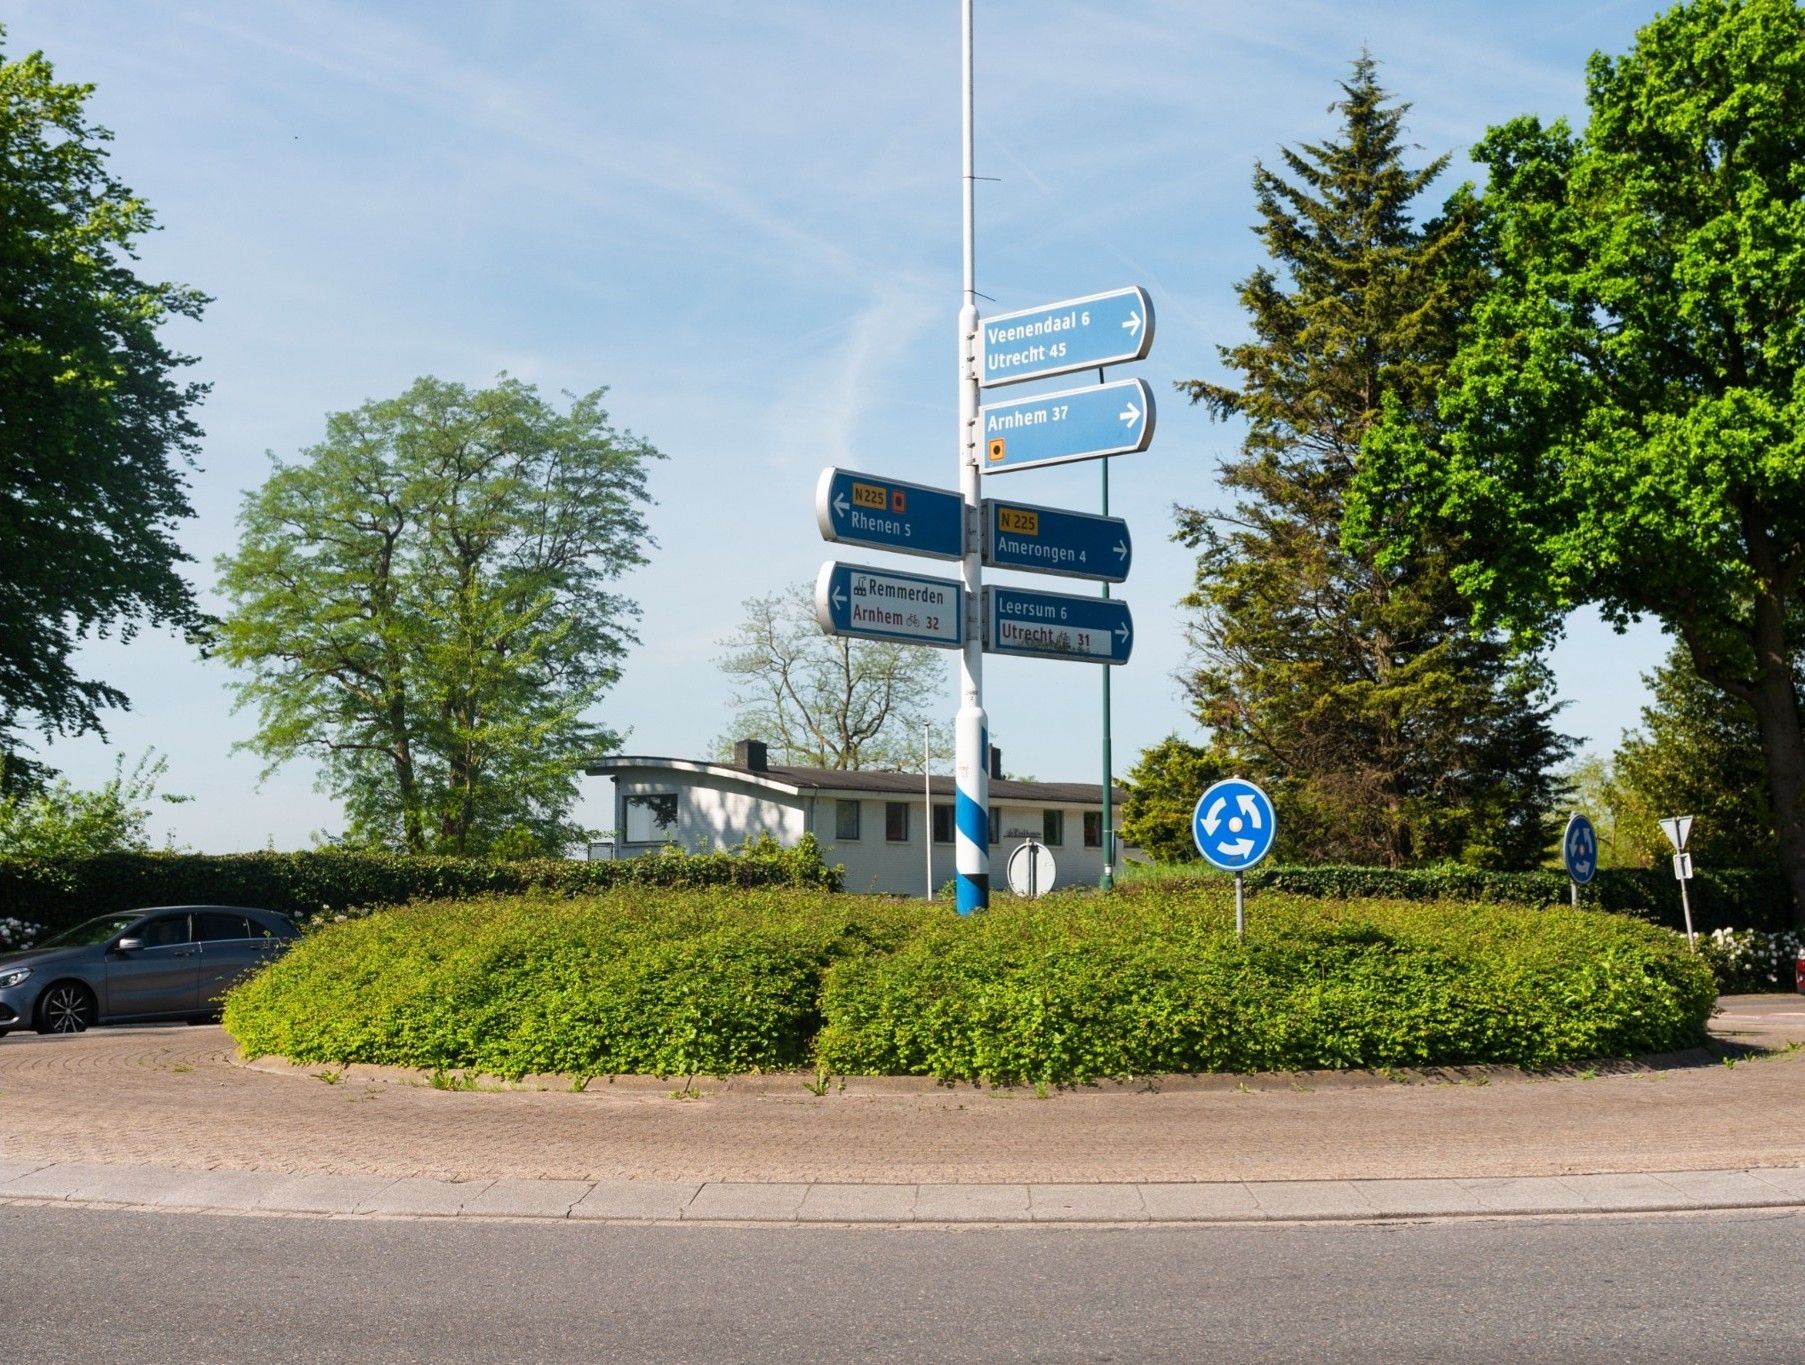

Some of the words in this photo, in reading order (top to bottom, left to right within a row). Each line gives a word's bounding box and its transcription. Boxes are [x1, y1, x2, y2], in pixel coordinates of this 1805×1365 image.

[988, 311, 1075, 344] Veenendaal
[1081, 312, 1090, 326] 6
[988, 345, 1045, 370] Utrecht
[1050, 342, 1067, 358] 45
[988, 409, 1046, 432] Arnhem
[1052, 406, 1069, 420] 37
[852, 511, 900, 535] Rhenen
[905, 523, 911, 537] 5
[998, 537, 1075, 563] Amerongen
[1079, 550, 1086, 564] 4
[870, 578, 944, 604] Remmerden
[853, 604, 903, 626] Arnhem
[926, 616, 940, 630] 32
[999, 597, 1056, 619] Leersum
[1060, 606, 1068, 620] 6
[1002, 622, 1053, 644] Utrecht
[1078, 633, 1090, 647] 31
